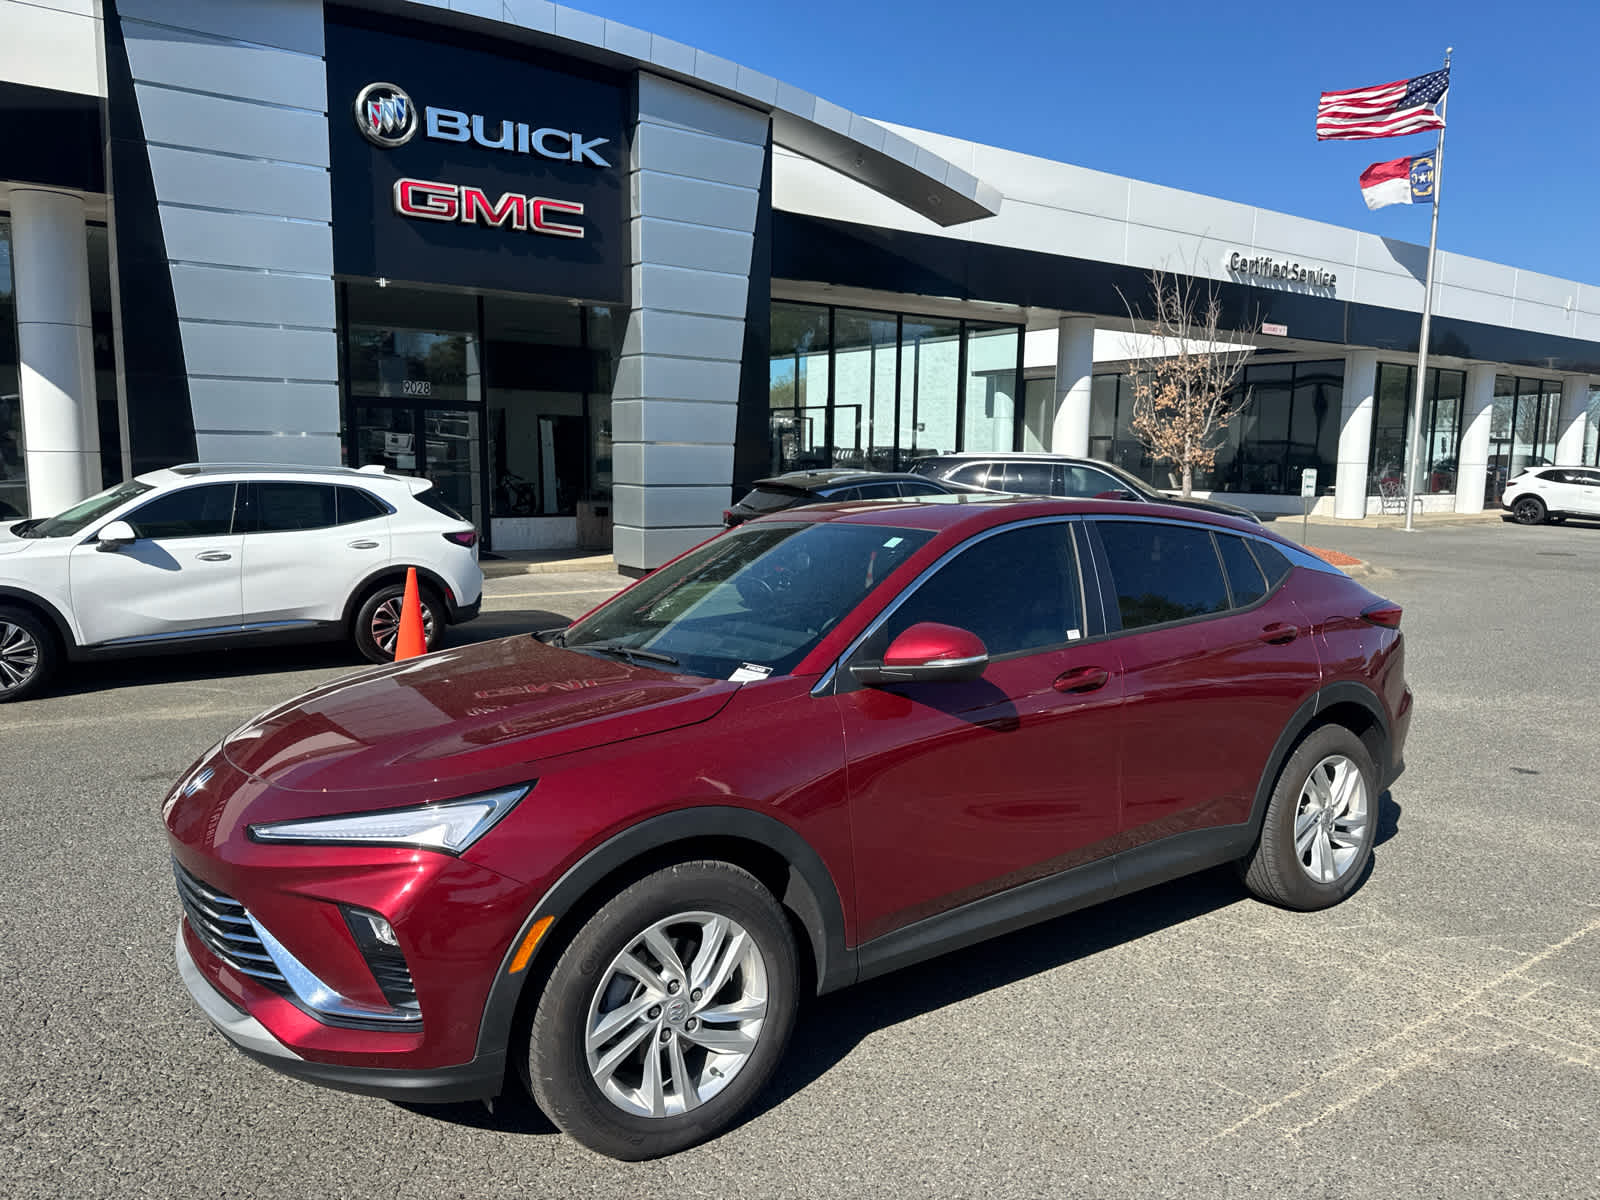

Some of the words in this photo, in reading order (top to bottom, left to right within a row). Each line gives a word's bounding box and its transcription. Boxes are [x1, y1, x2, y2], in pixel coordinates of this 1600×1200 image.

[425, 105, 612, 168] BUICK
[393, 177, 585, 239] GMC
[1230, 252, 1288, 279] Certified
[1291, 263, 1336, 287] Service
[404, 381, 430, 394] 9028
